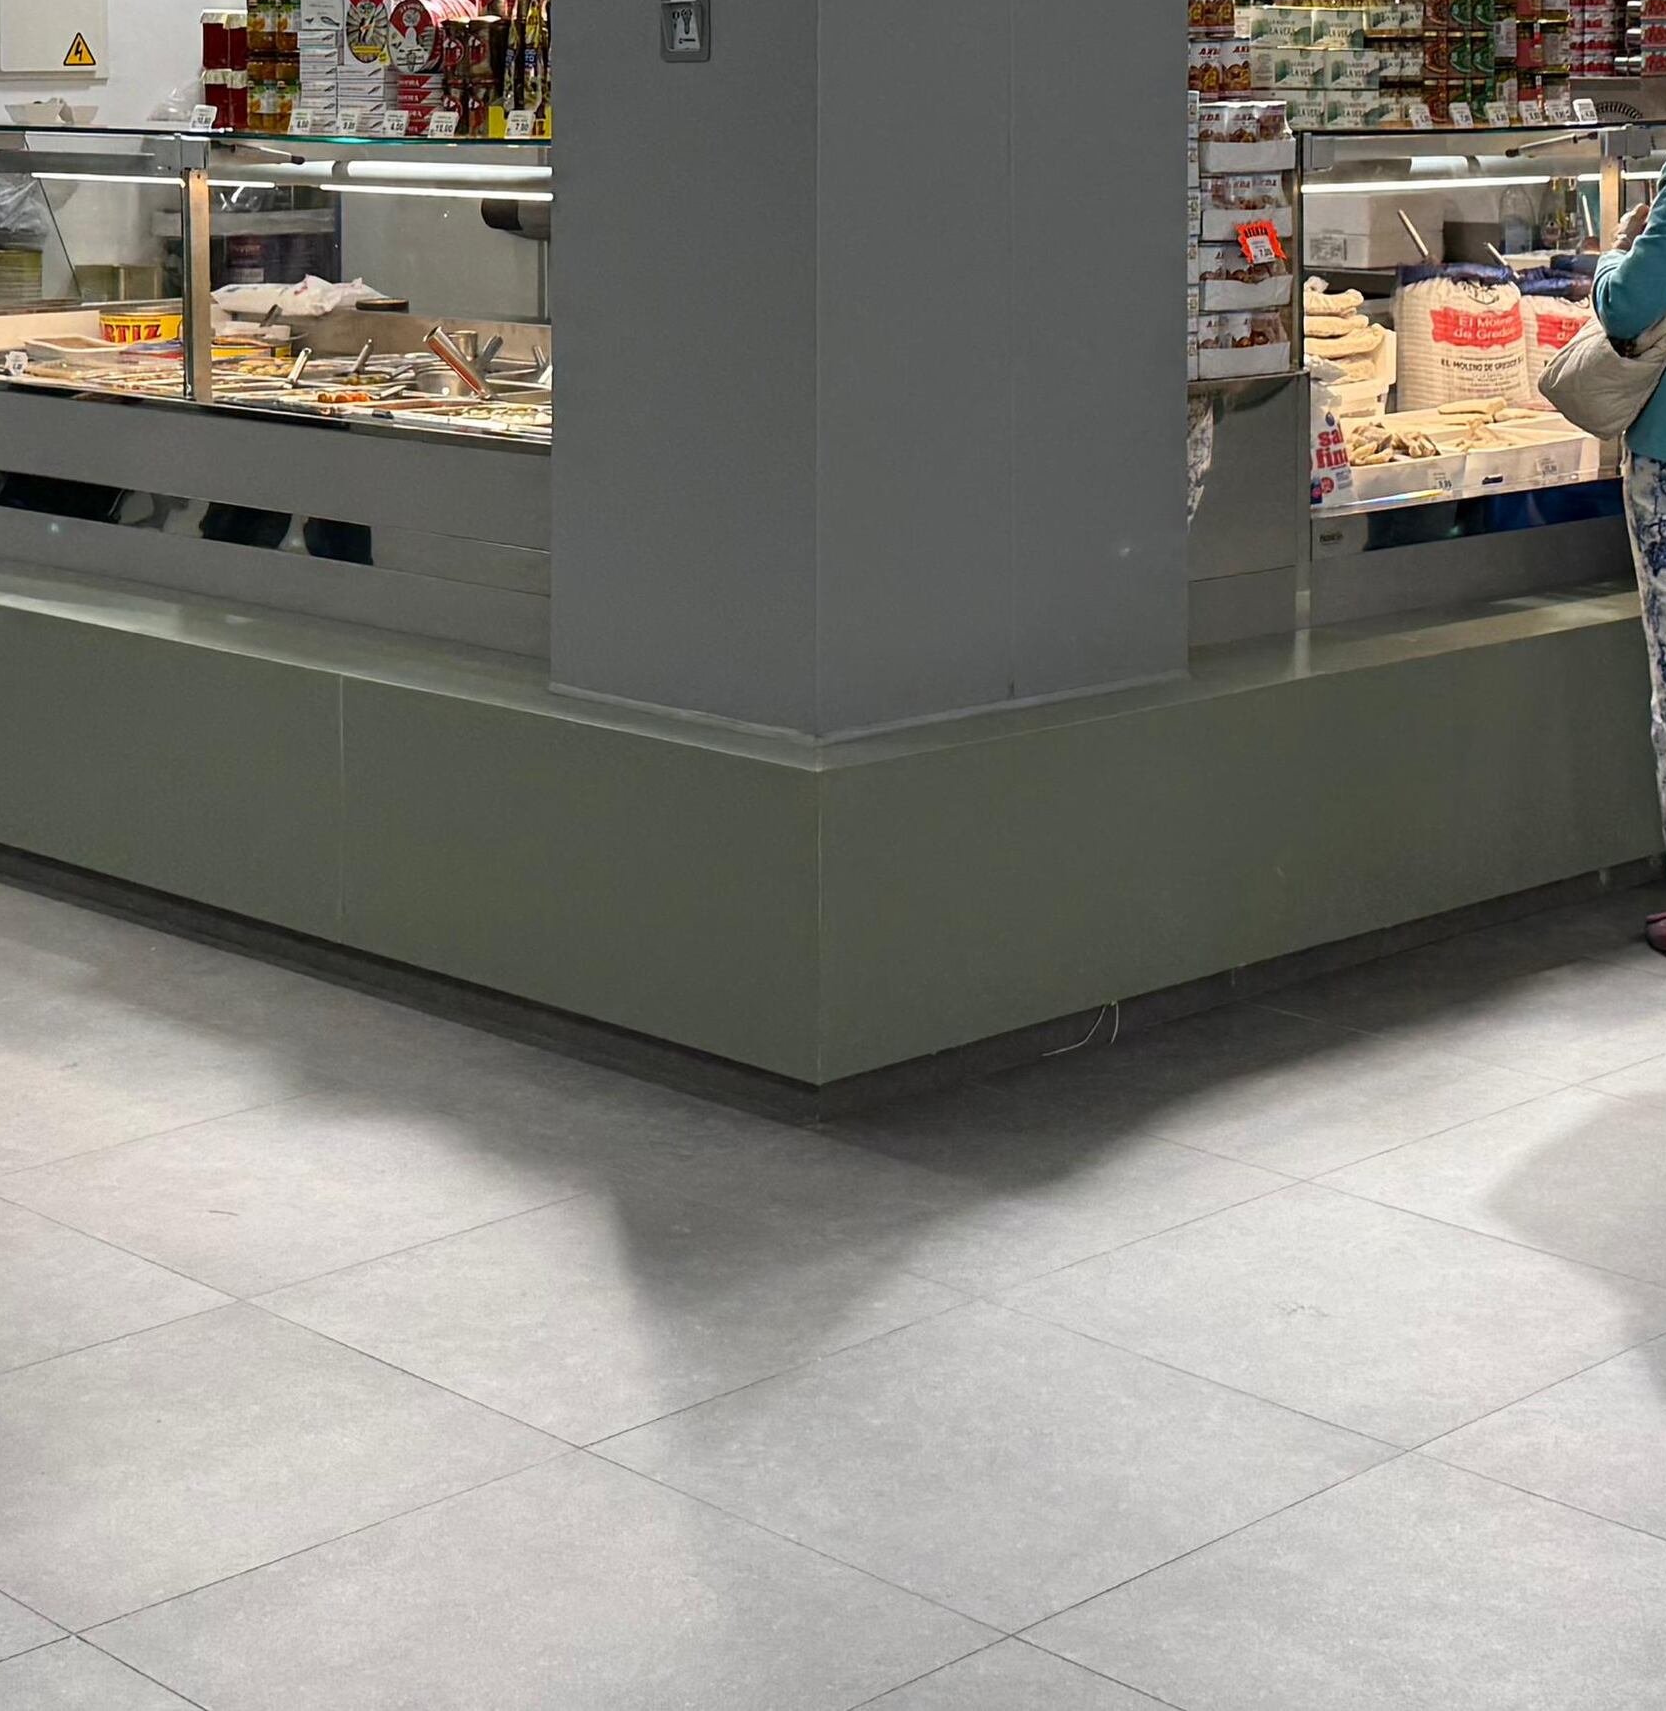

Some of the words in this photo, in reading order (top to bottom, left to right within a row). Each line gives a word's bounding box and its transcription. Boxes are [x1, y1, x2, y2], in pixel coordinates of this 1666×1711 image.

[102, 324, 162, 342] RTIZ
[1318, 423, 1345, 446] sal
[1315, 448, 1349, 469] fin
